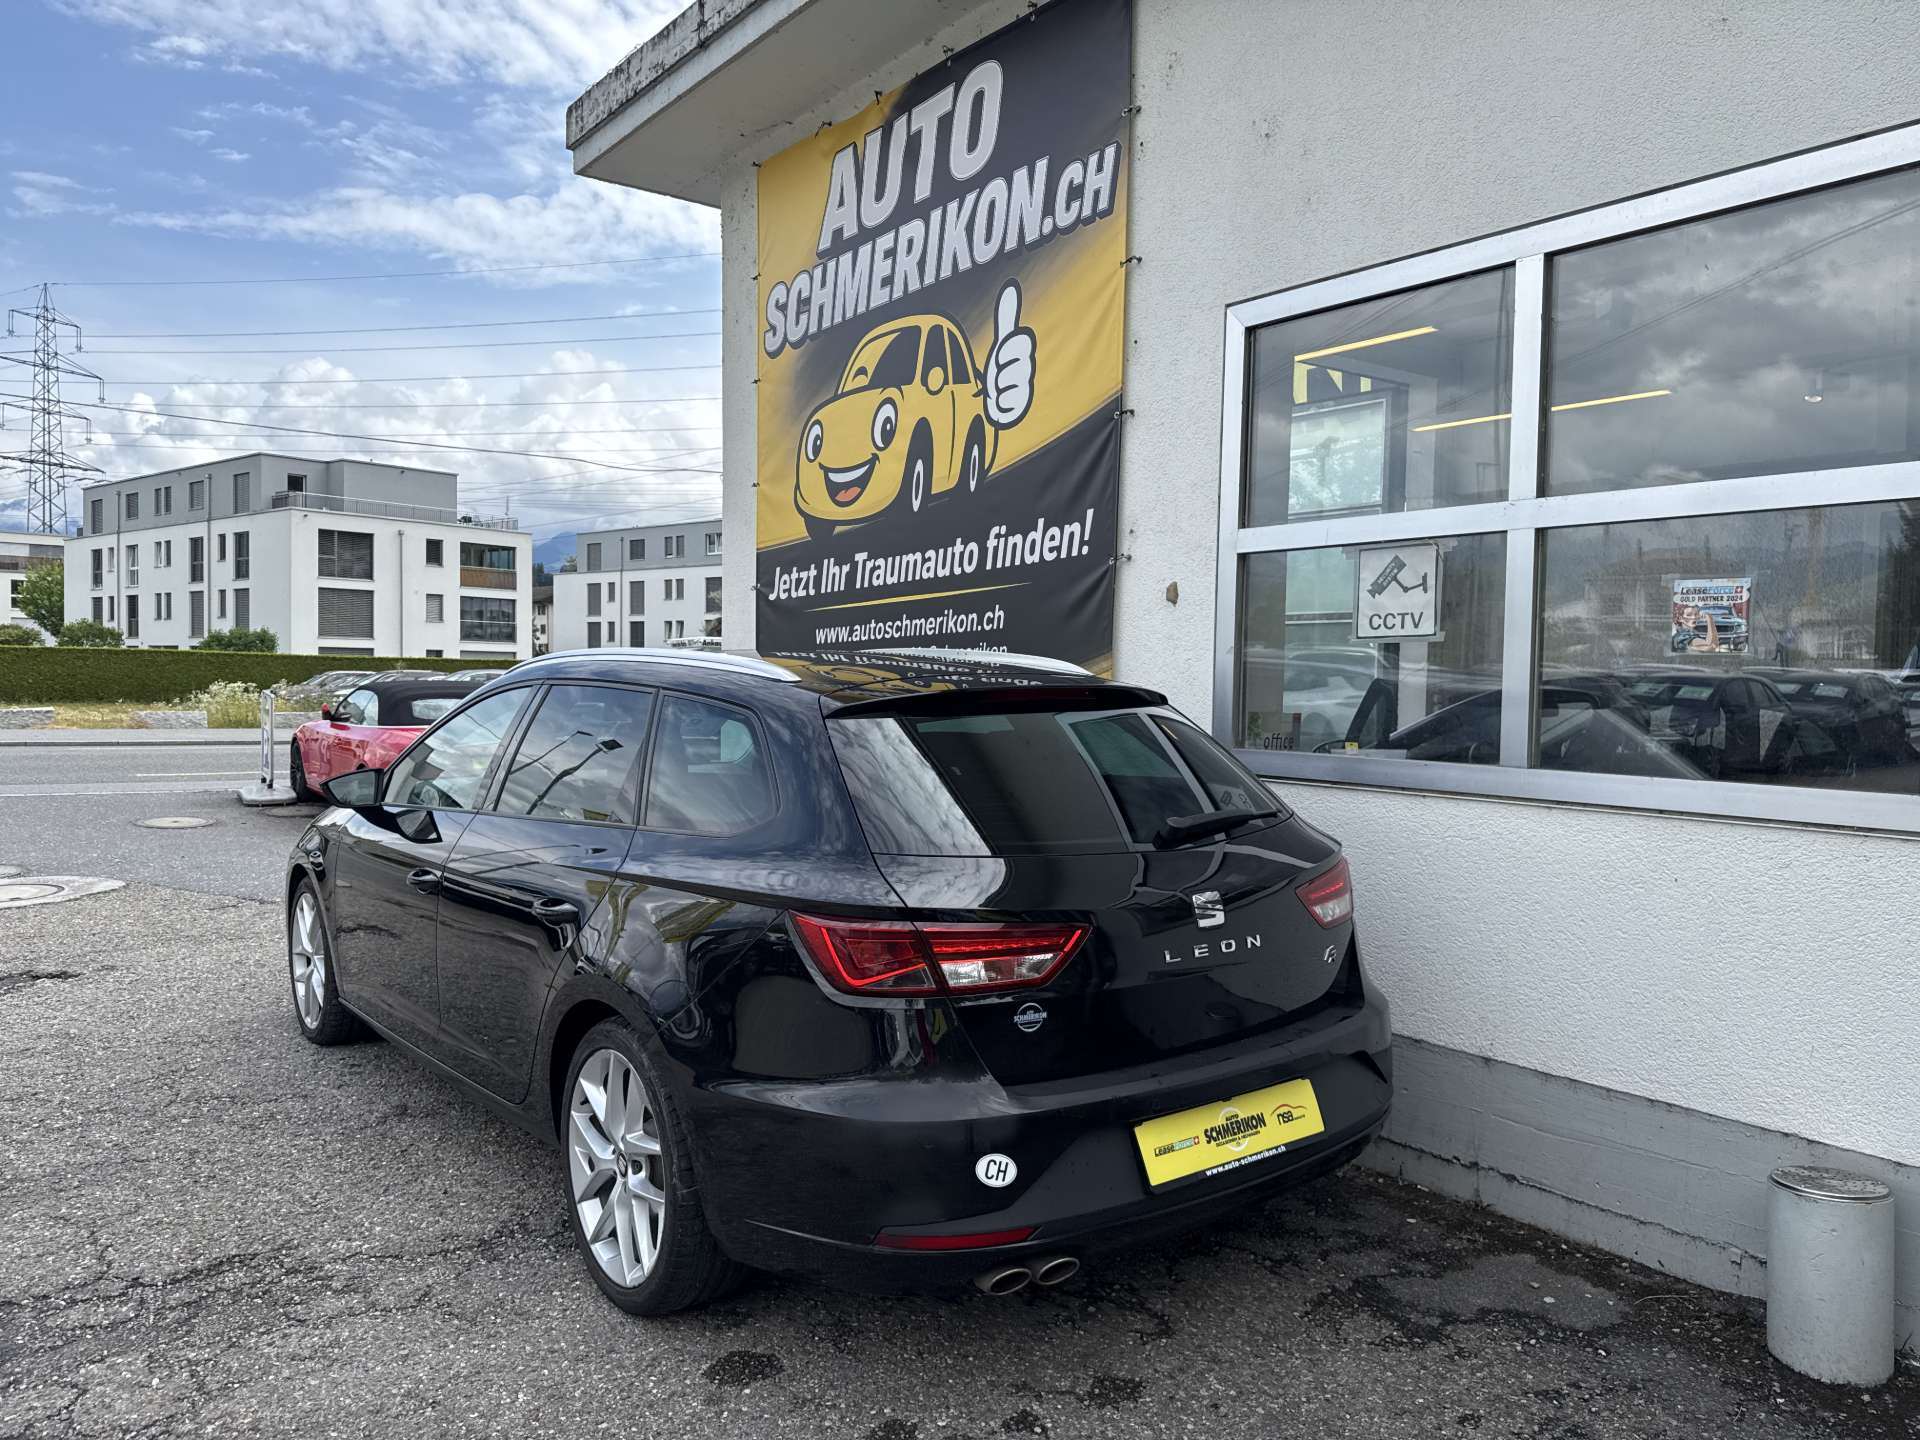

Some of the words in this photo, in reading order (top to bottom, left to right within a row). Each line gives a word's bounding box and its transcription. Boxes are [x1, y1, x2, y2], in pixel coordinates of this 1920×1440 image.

[817, 60, 1003, 254] AUTO
[764, 142, 1119, 355] SCHMERIKON.CH
[768, 567, 816, 601] Jetzt
[820, 558, 849, 592] Ihr
[854, 538, 978, 588] Traumauto
[986, 508, 1094, 570] finden!
[815, 605, 1005, 645] www.autoschmerikon.ch
[1369, 611, 1424, 631] CCTV
[1263, 733, 1294, 750] office
[1164, 934, 1261, 963] LEON
[1204, 1113, 1266, 1145] SCHMERIKON
[985, 1159, 1009, 1182] CH
[1205, 1145, 1287, 1176] www.auto-schmerikon.ch
